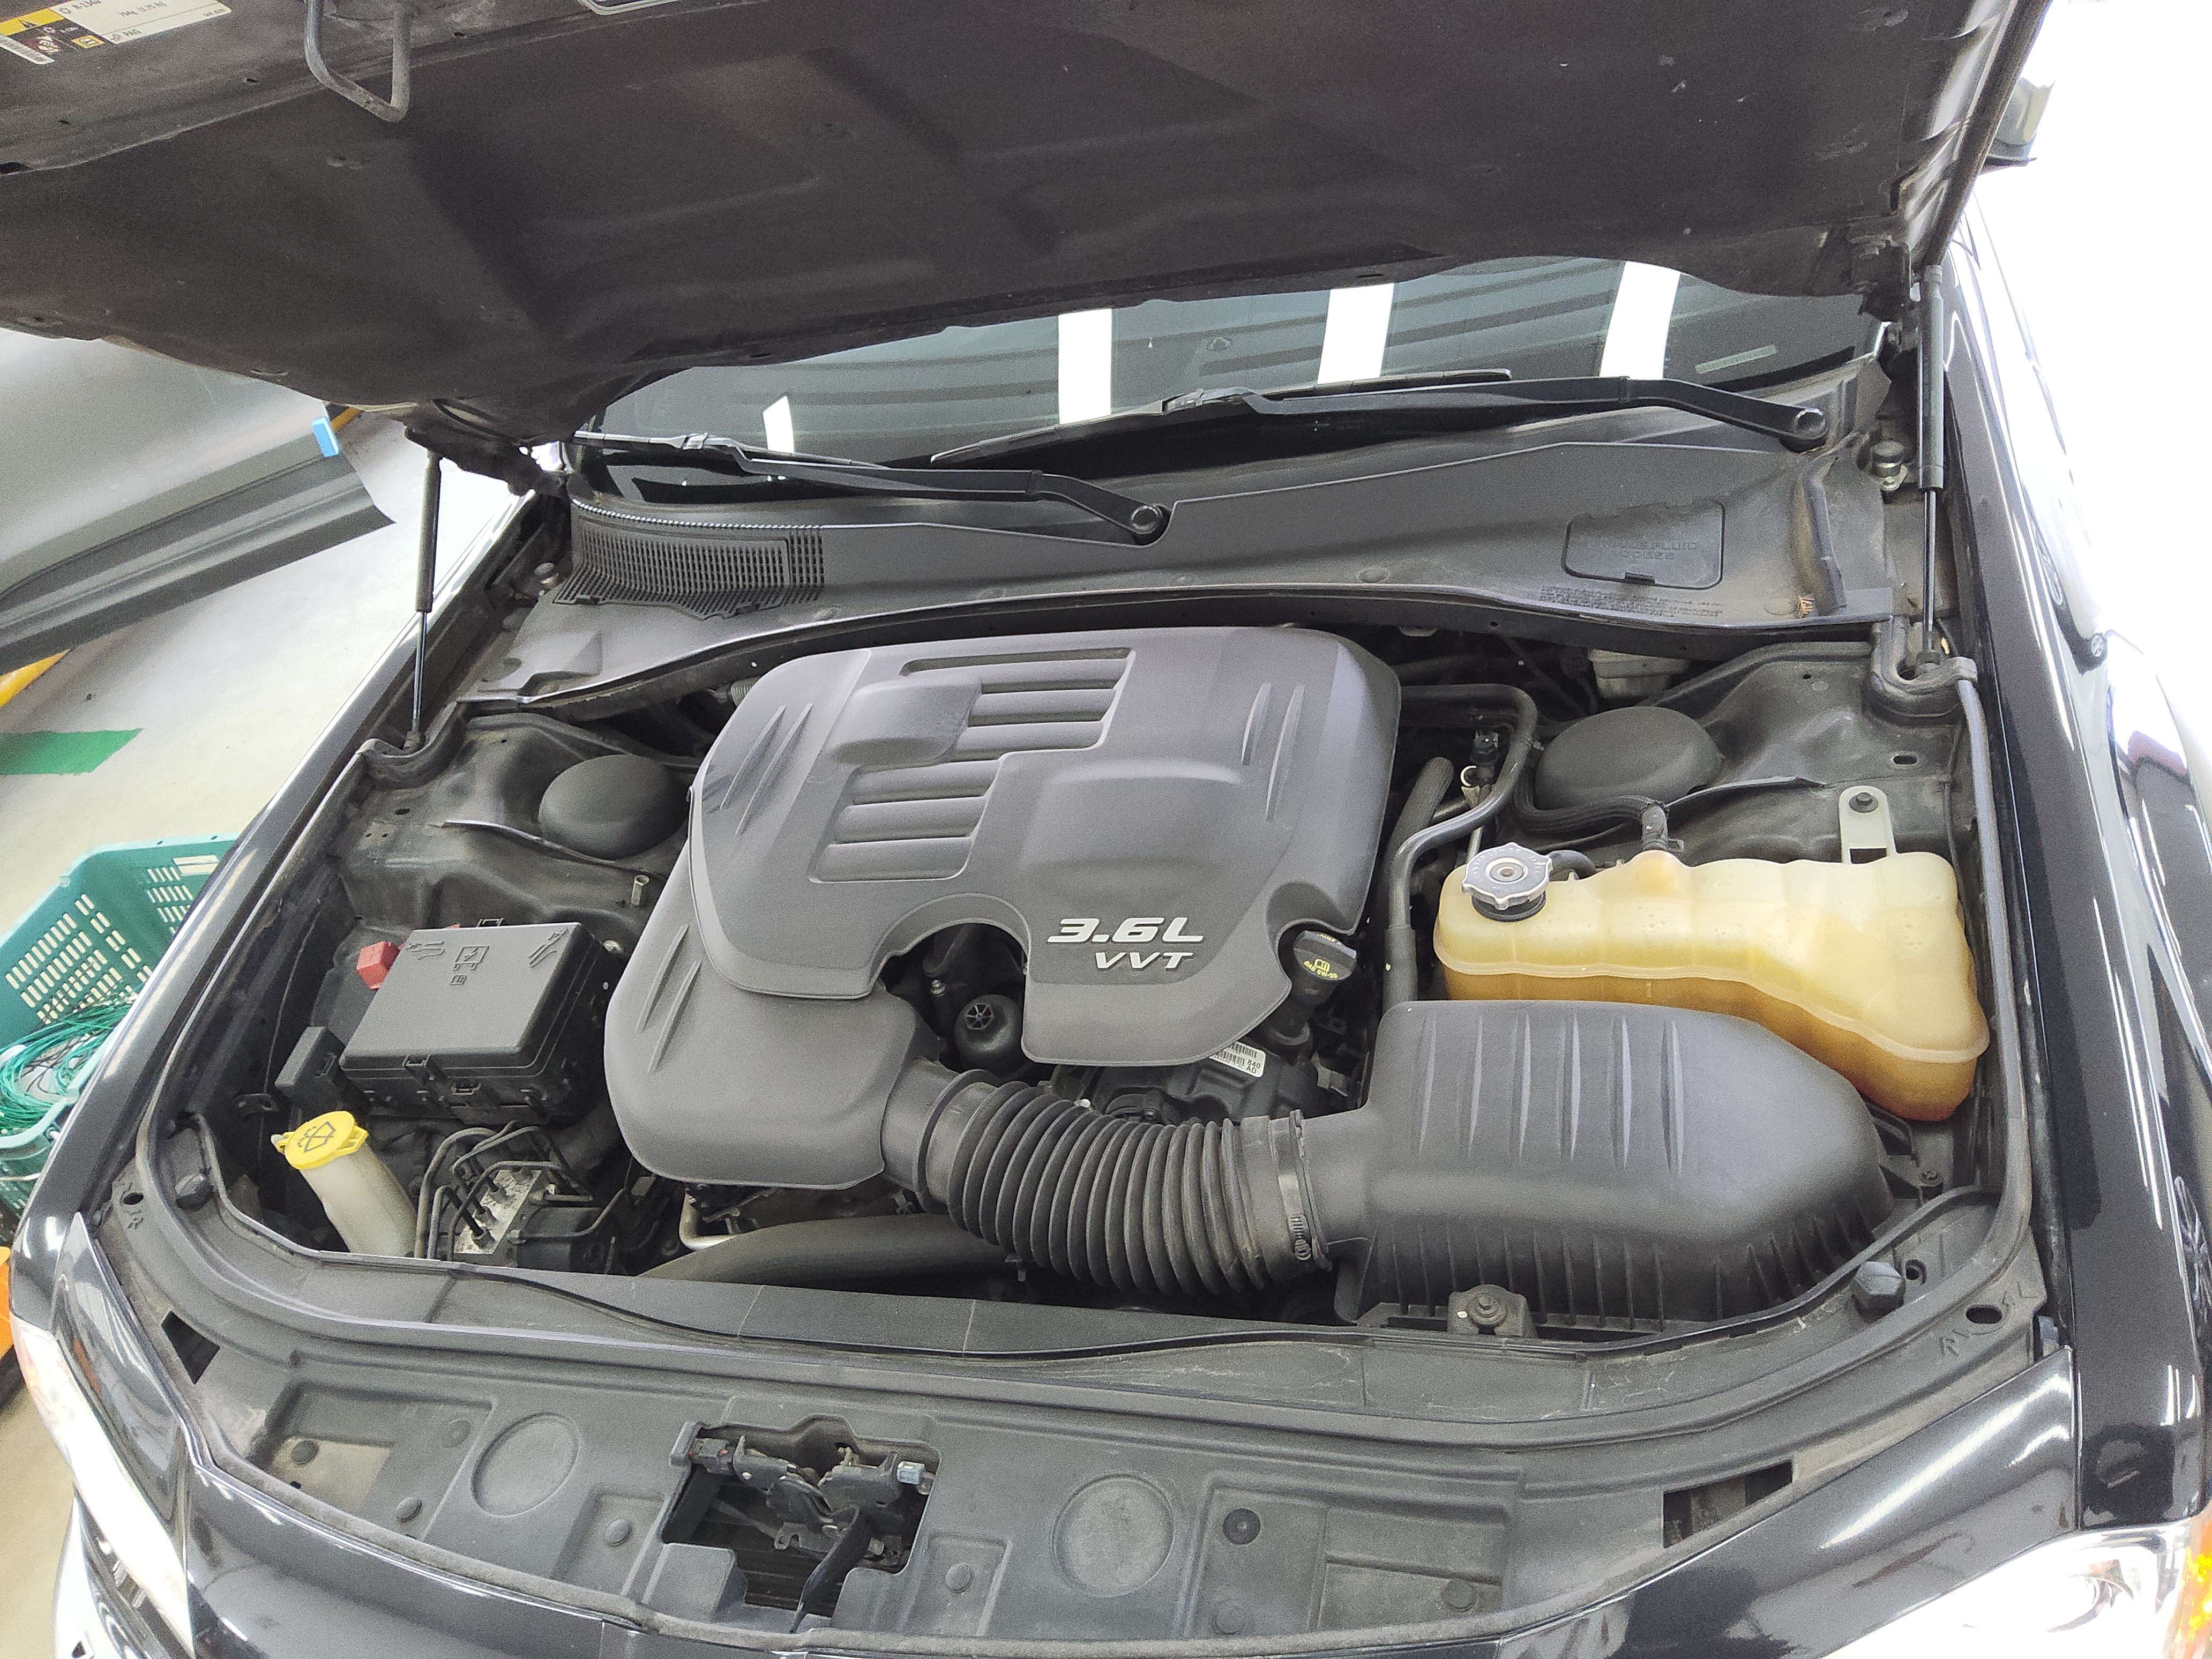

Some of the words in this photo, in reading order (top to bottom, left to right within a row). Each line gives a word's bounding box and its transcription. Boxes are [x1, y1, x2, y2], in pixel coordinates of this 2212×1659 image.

[1047, 917, 1204, 944] 3.6L
[1095, 952, 1194, 970] VVT
[1246, 1059, 1261, 1069] 840
[1246, 1065, 1257, 1074] AD
